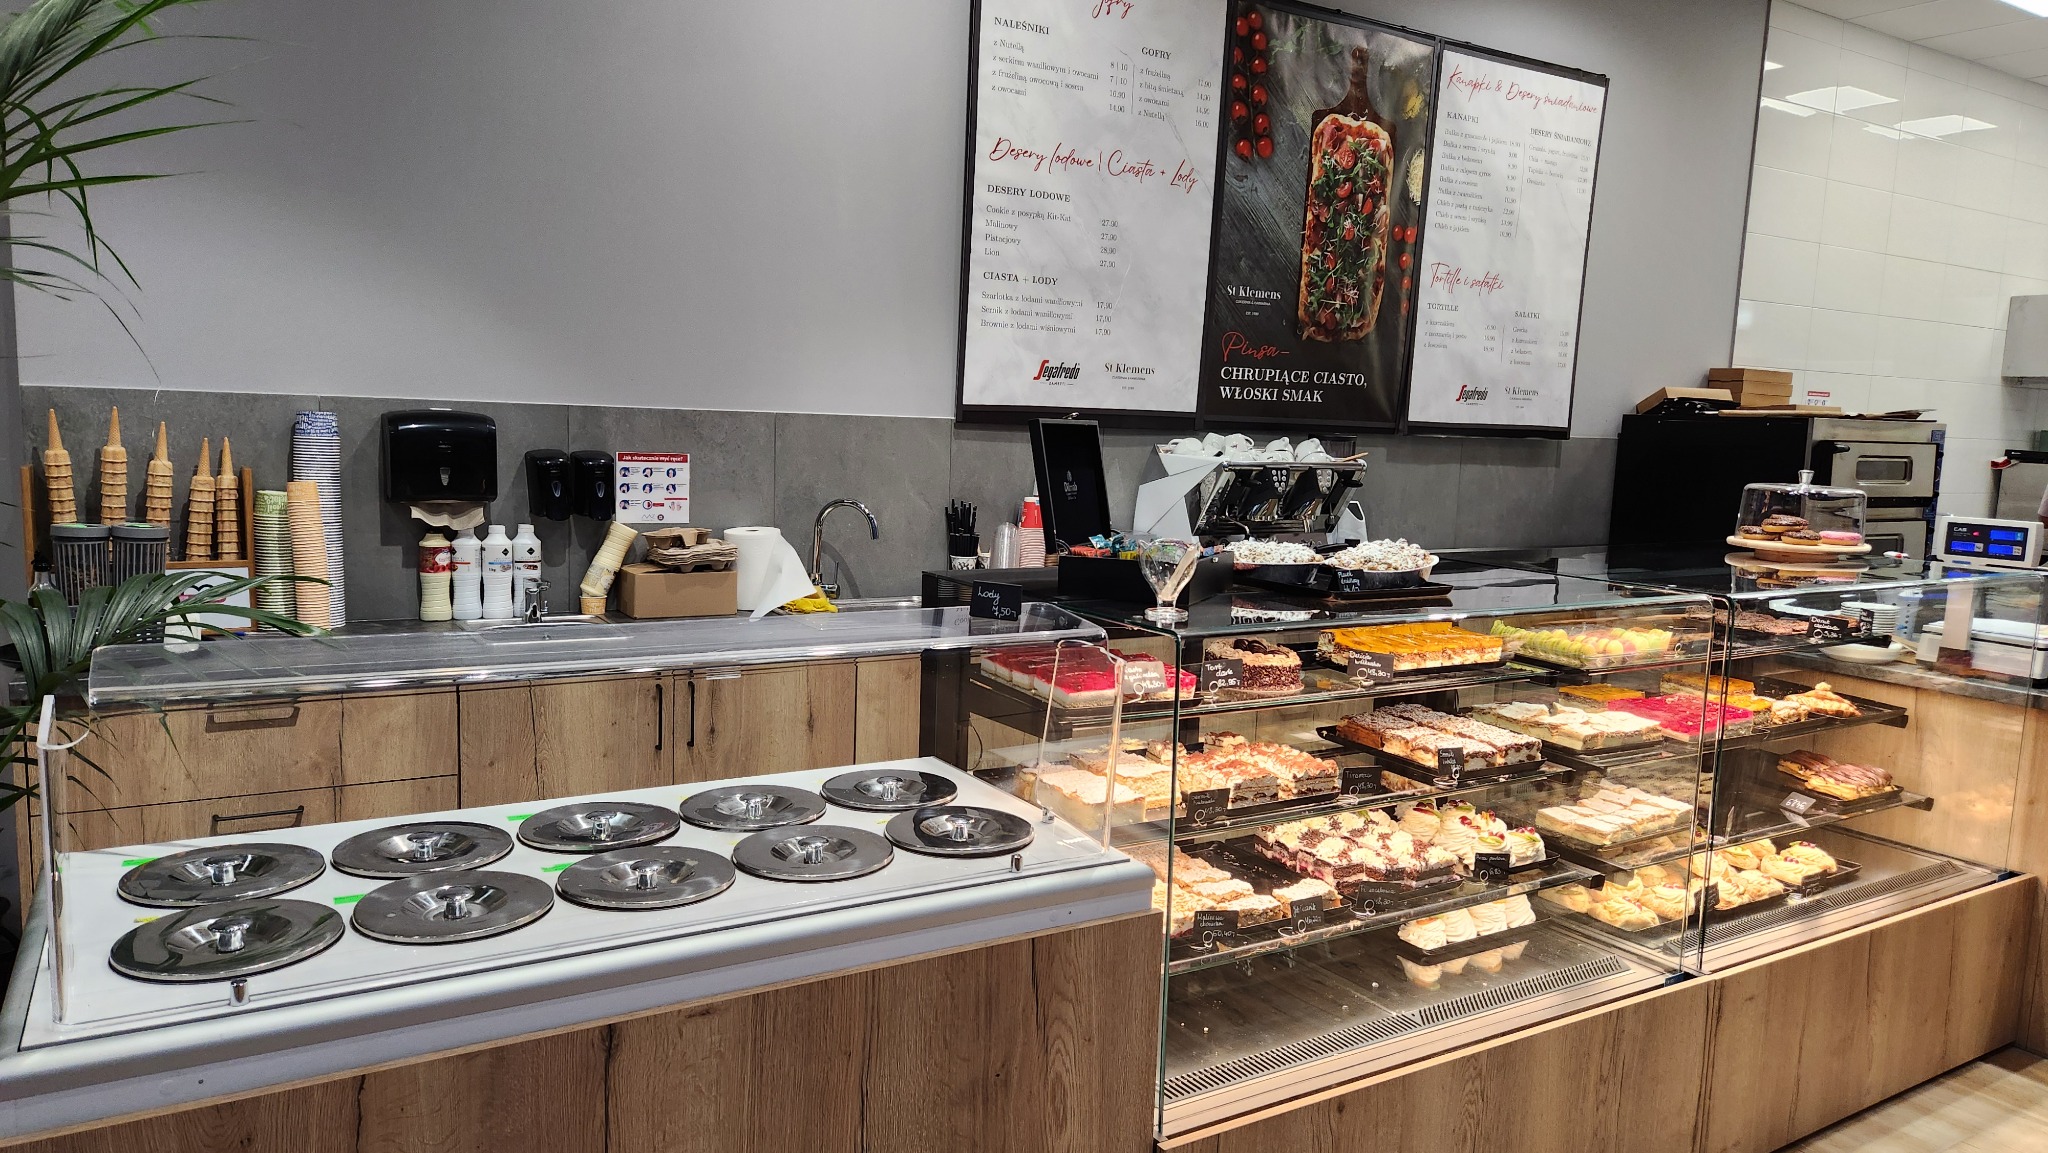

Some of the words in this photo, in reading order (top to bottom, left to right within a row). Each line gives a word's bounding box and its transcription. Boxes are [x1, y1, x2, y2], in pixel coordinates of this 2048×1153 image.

[994, 16, 1049, 35] NALEŚNIKI
[1000, 39, 1024, 53] Nutellą
[1141, 46, 1172, 60] GOFRY
[1447, 64, 1492, 103] Kanapki
[1506, 81, 1542, 109] Desery
[1446, 111, 1479, 123] KANAPKI
[988, 137, 1048, 172] Desery
[1048, 142, 1094, 174] lodowe
[1107, 149, 1156, 183] Ciasta
[1170, 159, 1199, 194] Lody
[987, 184, 1027, 197] DESERY
[1029, 190, 1071, 203] LODOWE
[986, 204, 1010, 215] Cookie
[1017, 210, 1045, 221] posypką
[1047, 212, 1072, 222] Kit-Kat
[984, 248, 1000, 256] Lion
[983, 271, 1020, 283] CIASTA
[1032, 275, 1058, 286] LODY
[1430, 262, 1462, 294] Tortille
[981, 291, 1014, 302] Szarlotka
[1227, 284, 1236, 296] St
[1239, 285, 1282, 300] Klemens
[981, 305, 1003, 315] Sernik
[1427, 302, 1459, 312] TORTILLE
[980, 319, 1009, 329] Brownie
[1033, 359, 1081, 381] Segafredo
[1104, 362, 1113, 373] St
[1116, 363, 1156, 375] Klemens
[1220, 366, 1310, 385] CHRUPIĄCE
[1313, 371, 1367, 388] CIASTO,
[1219, 386, 1279, 401] WŁOSKI
[1281, 388, 1323, 403] SMAK
